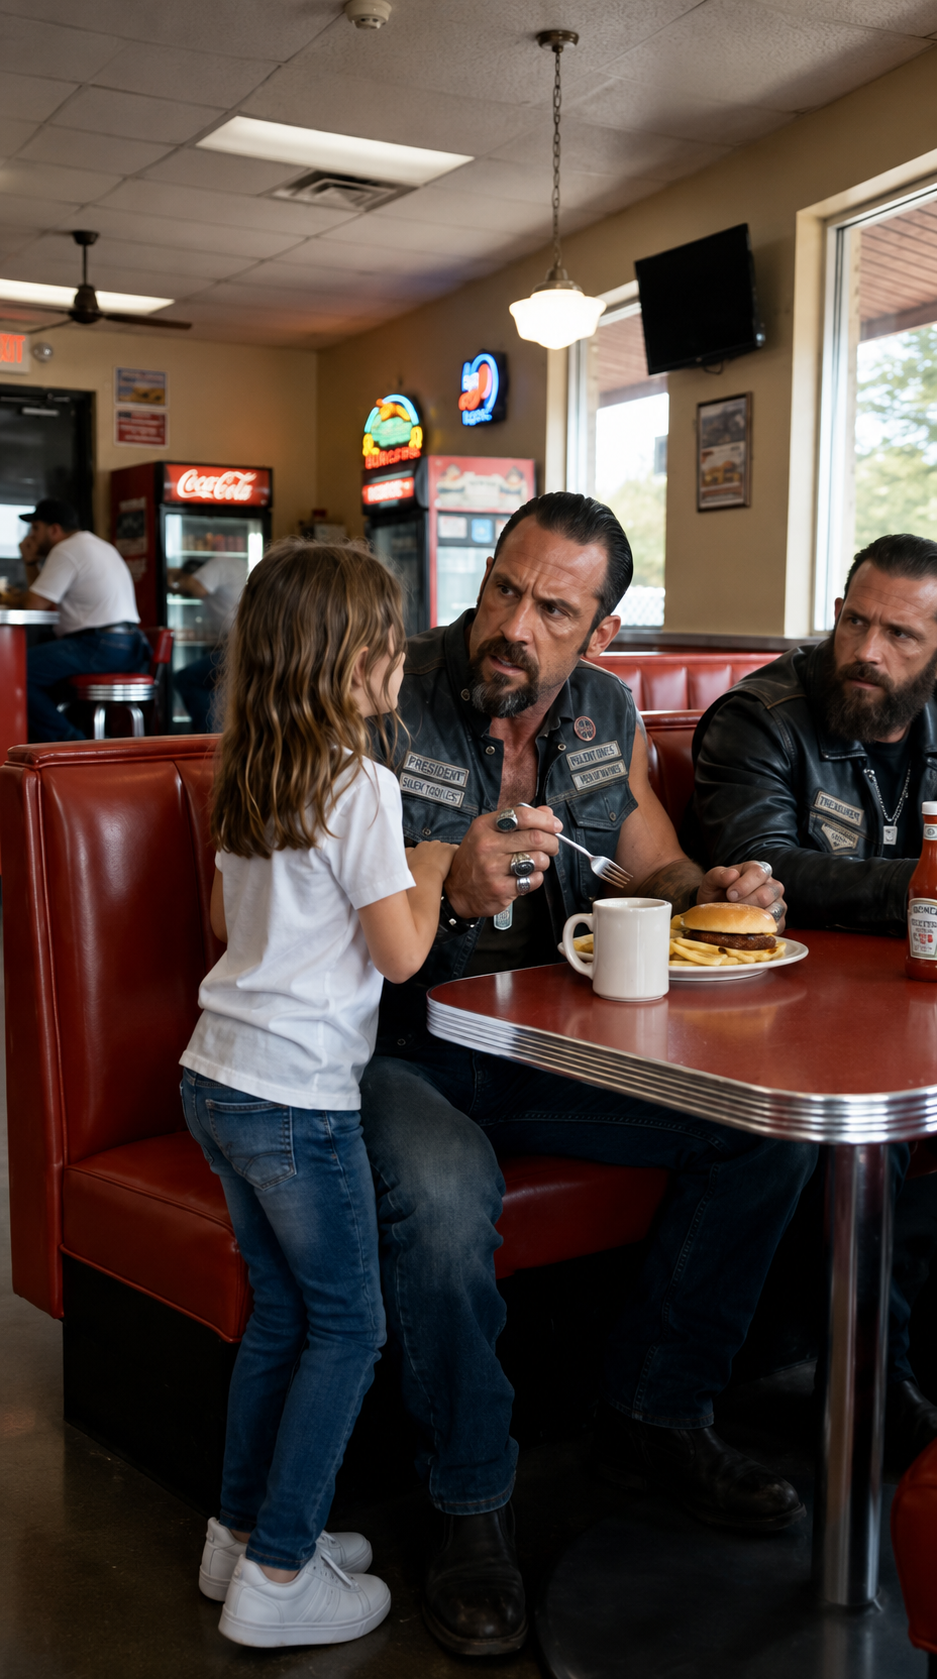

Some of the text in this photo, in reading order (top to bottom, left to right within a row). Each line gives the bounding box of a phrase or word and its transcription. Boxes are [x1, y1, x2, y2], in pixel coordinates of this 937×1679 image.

[0, 333, 25, 363] XIT
[177, 469, 257, 501] Coca-Cola
[407, 755, 465, 781] PRESIDENT
